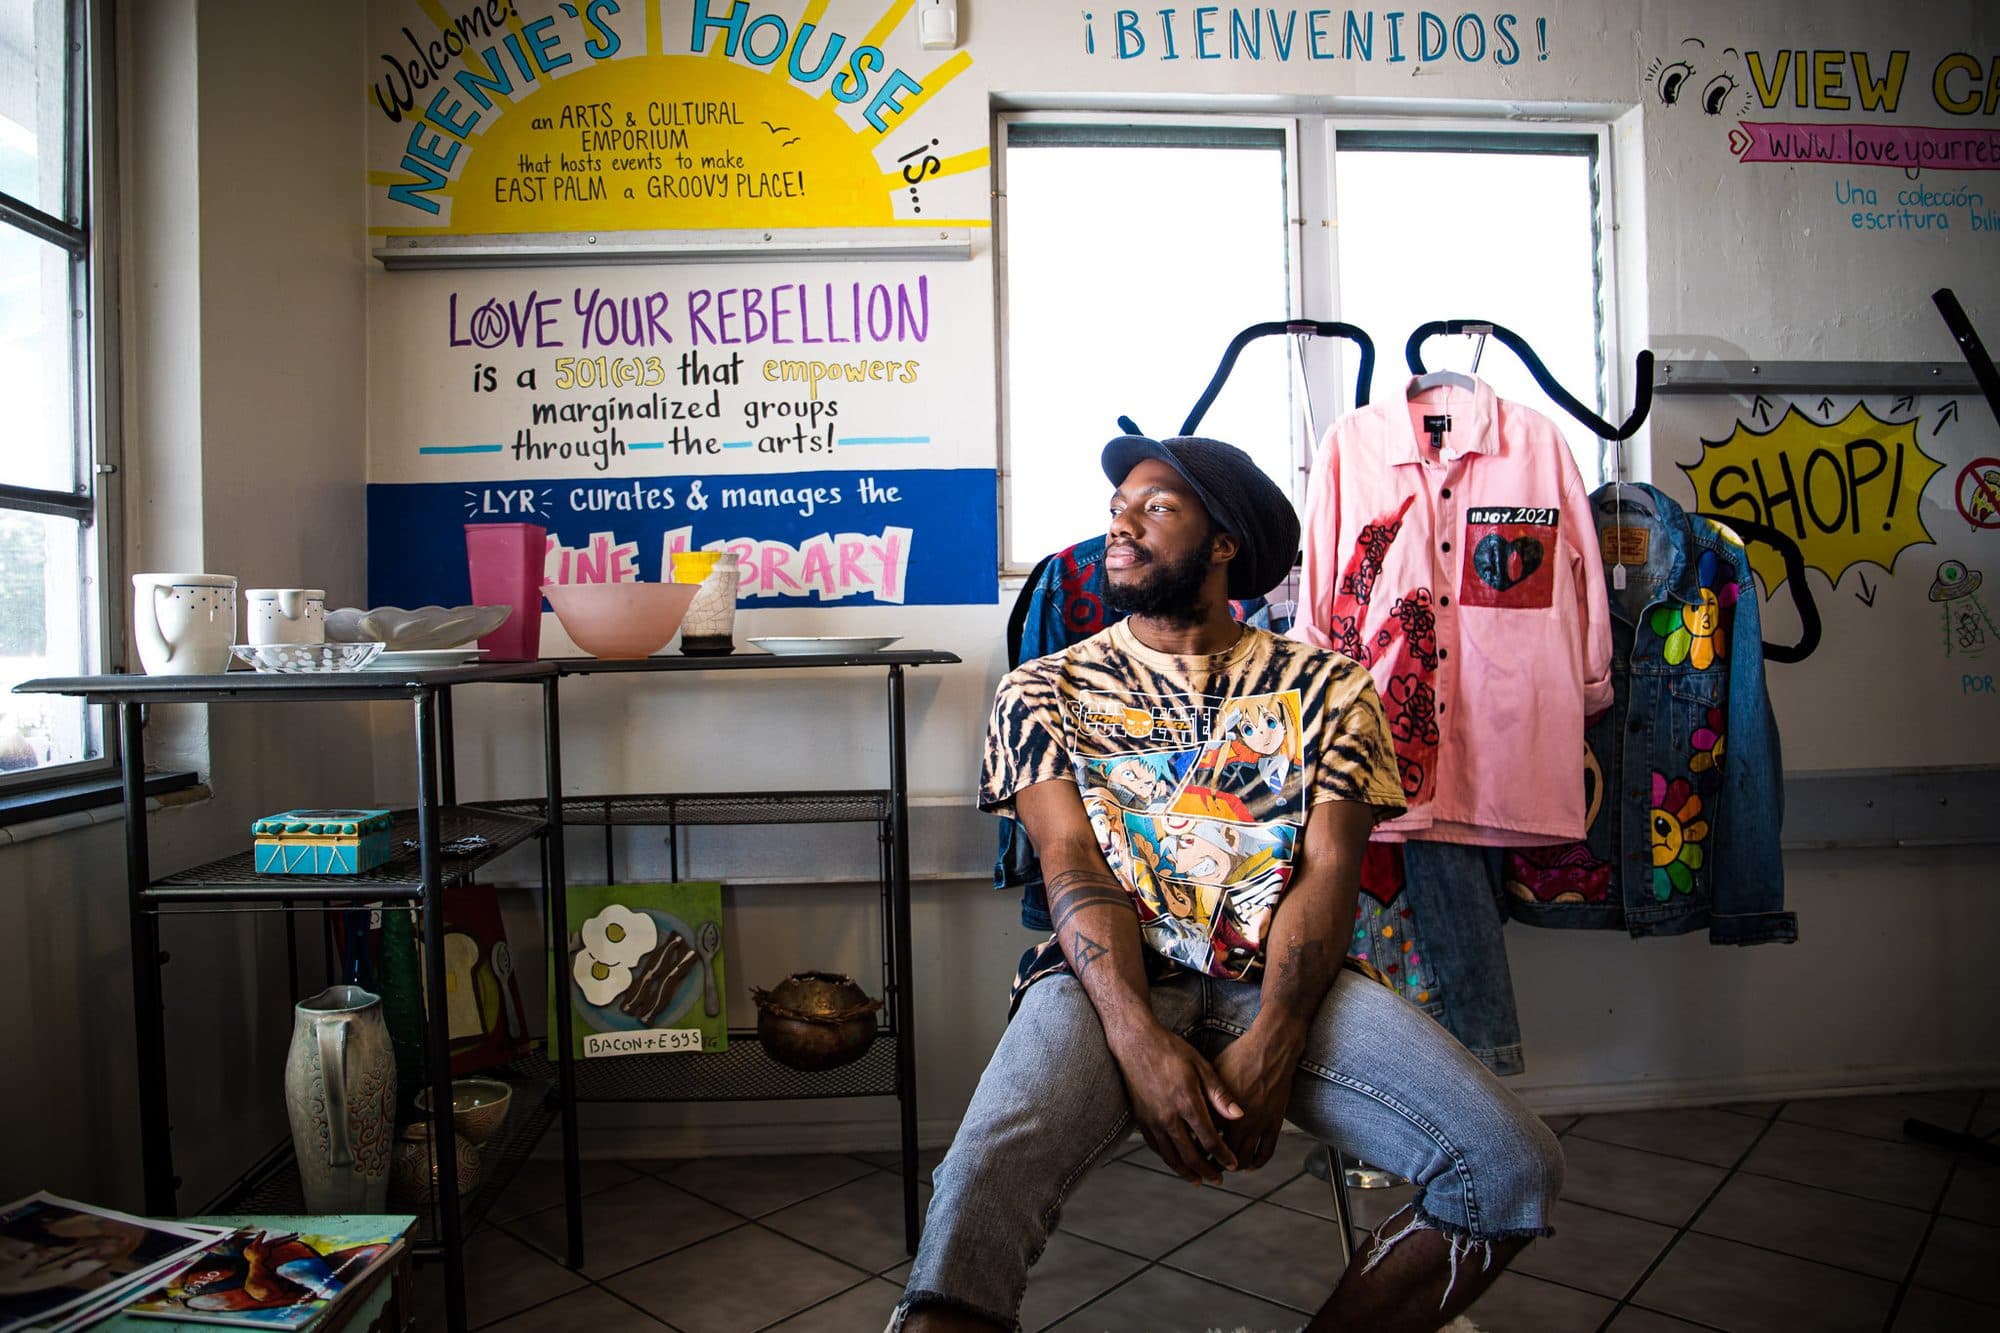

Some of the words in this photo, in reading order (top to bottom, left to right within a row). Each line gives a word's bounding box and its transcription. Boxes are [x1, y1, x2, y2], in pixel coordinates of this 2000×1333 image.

[1082, 7, 1549, 66] ¡BIENVENIDOS!
[1745, 50, 1910, 112] VIEW
[388, 0, 622, 216] NEENIE'S
[690, 0, 924, 134] HOUSE
[531, 115, 553, 130] an
[559, 102, 613, 128] ARTS
[625, 111, 637, 127] &
[648, 101, 744, 126] CULTURAL
[517, 153, 552, 173] that
[561, 151, 602, 173] hosts
[612, 151, 663, 171] events
[675, 151, 693, 170] to
[701, 149, 744, 169] make
[582, 129, 689, 152] EMPORIUM
[495, 177, 547, 203] EAST
[554, 176, 607, 201] PALM
[624, 186, 635, 200] a
[647, 173, 729, 199] GROOVY
[737, 170, 806, 198] PLACE!
[1835, 180, 1878, 207] Una
[1898, 184, 1983, 209] colección
[1851, 209, 1949, 232] escritura
[574, 288, 673, 349] YOUR
[689, 274, 930, 346] REBELLION
[474, 363, 498, 392] is
[516, 367, 537, 390] a
[555, 356, 665, 389] 501(c)3
[677, 350, 744, 386] that
[762, 359, 920, 400] empowers
[532, 389, 721, 433] marginalized
[743, 399, 838, 429] groups
[511, 427, 626, 471] through
[668, 425, 721, 455] the
[758, 422, 834, 454] arts!
[483, 489, 536, 515] LYR
[569, 482, 675, 512] curates
[686, 479, 709, 511] &
[721, 486, 842, 517] manages
[856, 477, 903, 504] the
[1709, 438, 1904, 540] SHOP!
[543, 530, 639, 585] INE
[668, 534, 899, 598] BRARY
[1961, 674, 1997, 695] POR
[588, 1036, 643, 1055] BACON
